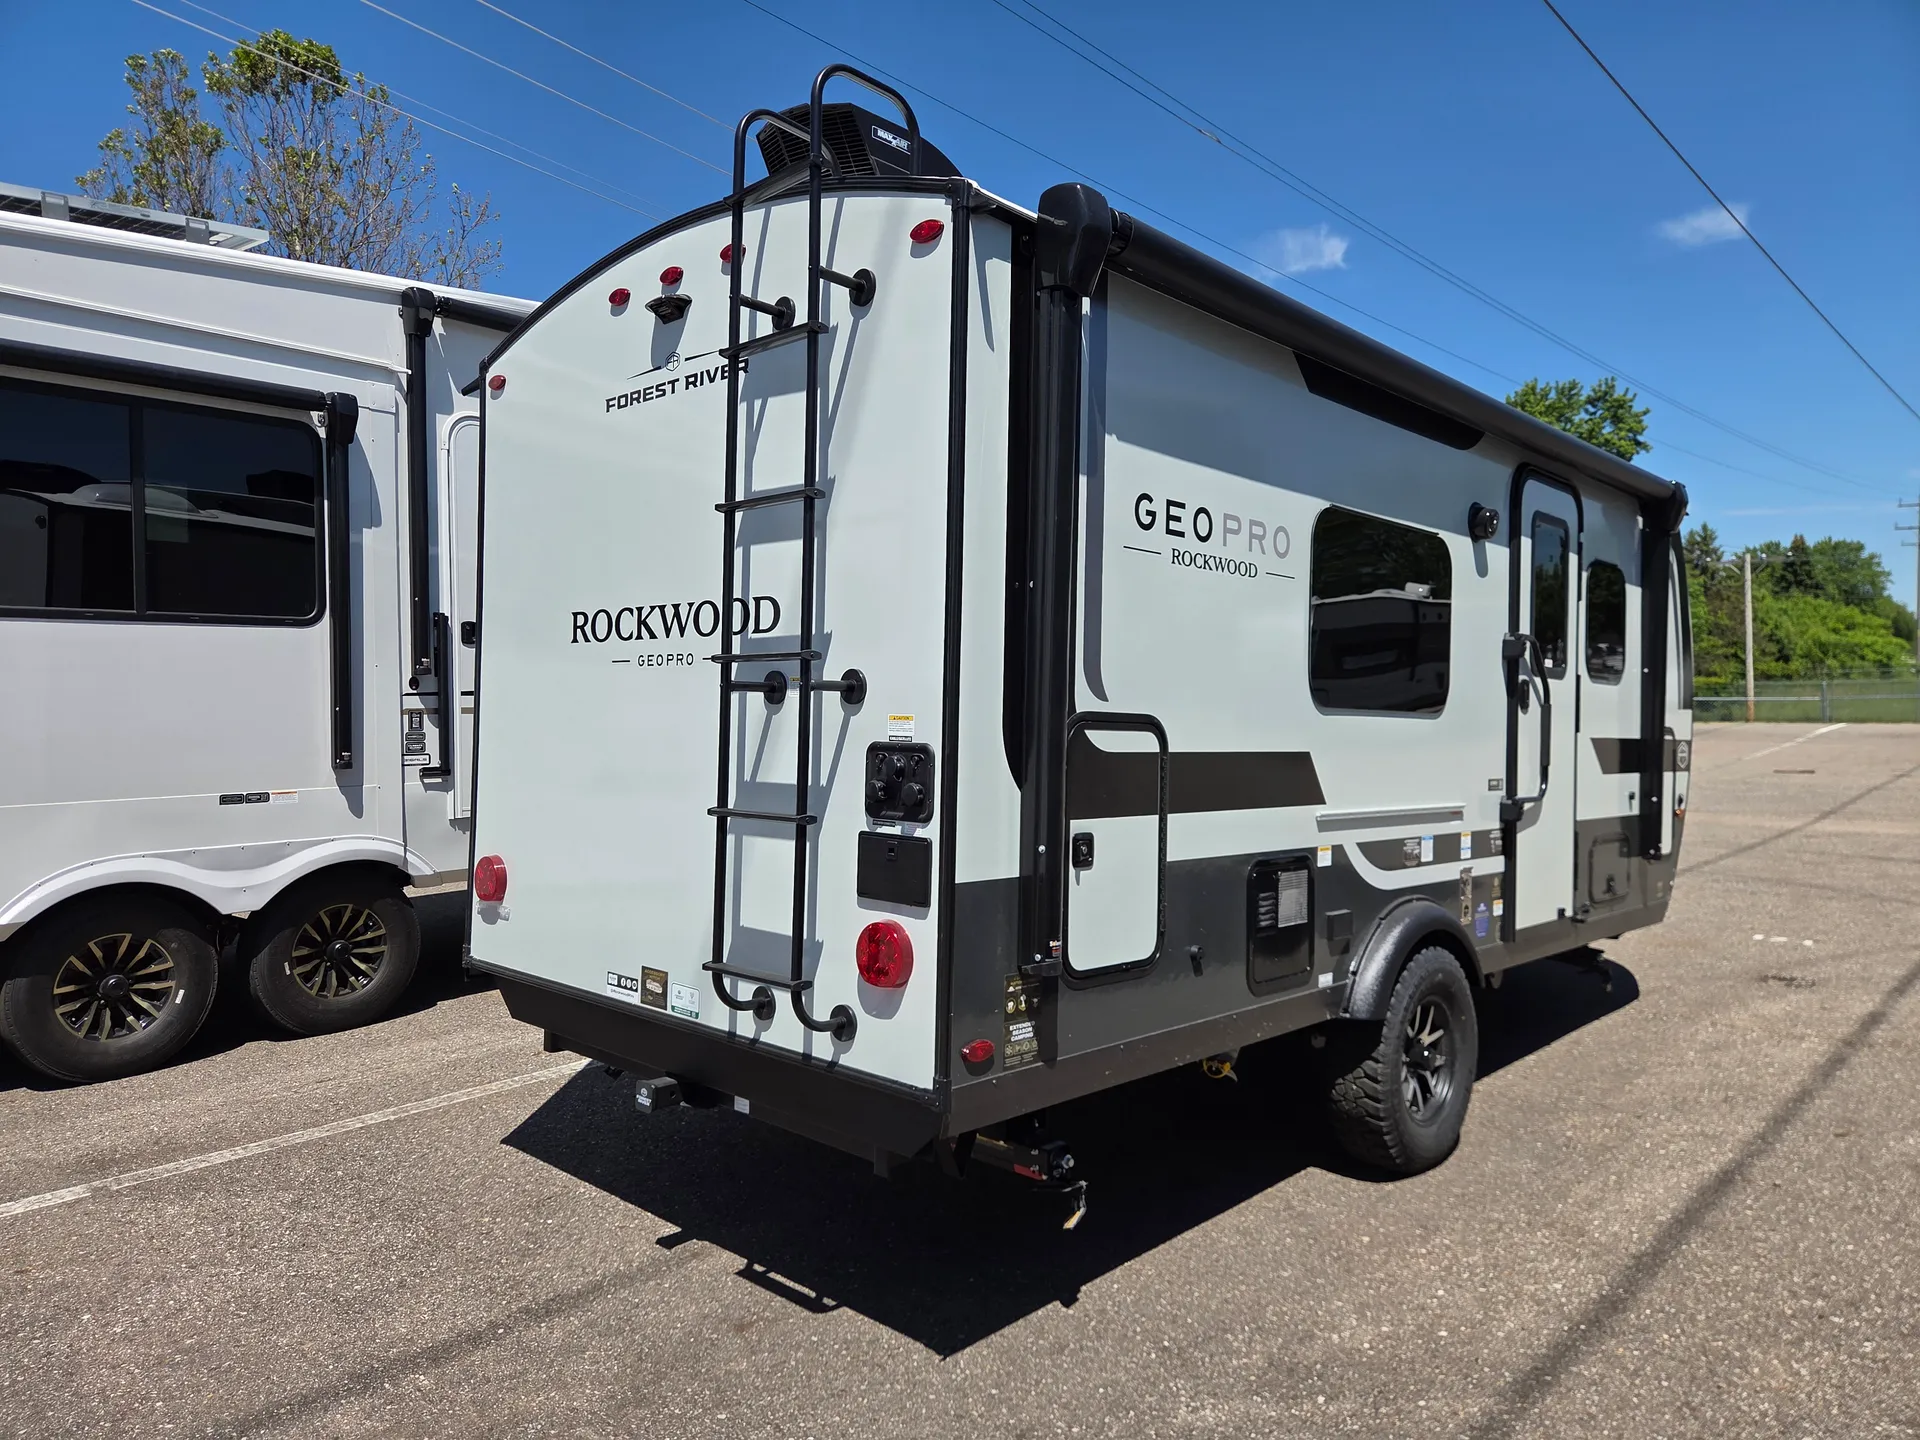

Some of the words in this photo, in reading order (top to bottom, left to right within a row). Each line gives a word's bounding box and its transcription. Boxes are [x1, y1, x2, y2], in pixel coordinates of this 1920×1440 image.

[605, 378, 680, 413] FOREST
[684, 358, 749, 391] RIVER
[1171, 548, 1258, 579] ROCKWOOD
[570, 595, 781, 644] ROCKWOOD
[637, 652, 694, 667] GEOPRO
